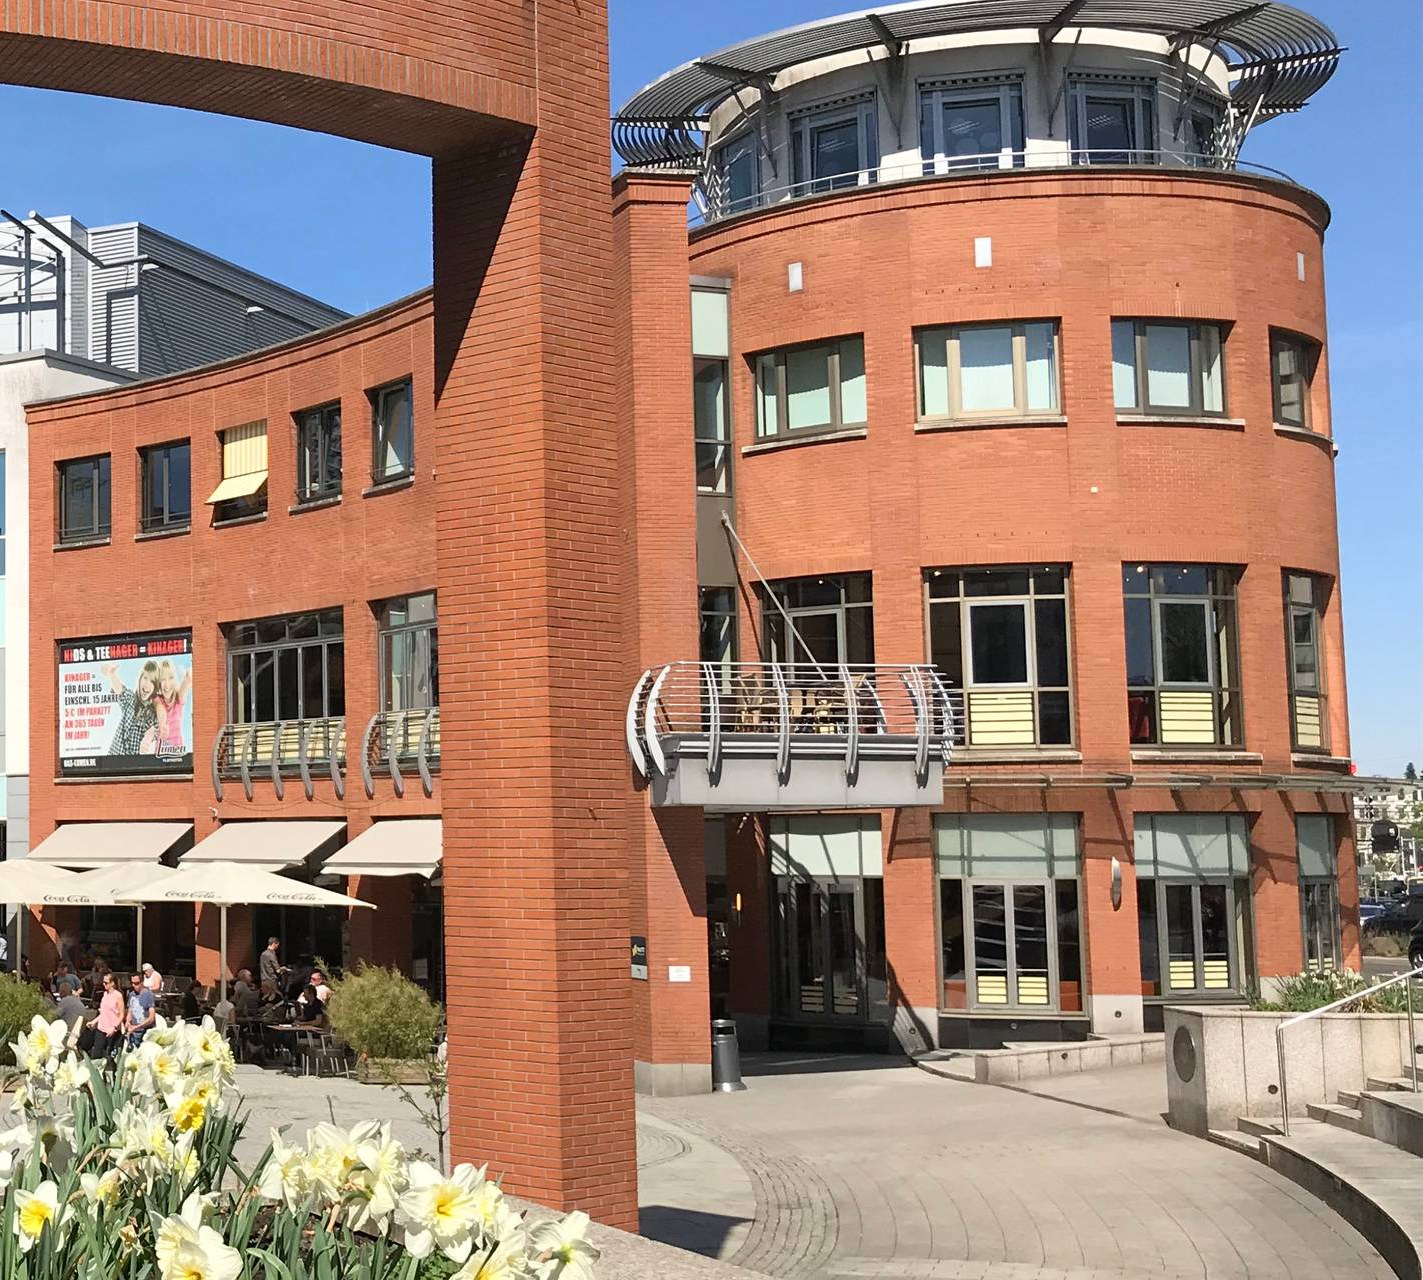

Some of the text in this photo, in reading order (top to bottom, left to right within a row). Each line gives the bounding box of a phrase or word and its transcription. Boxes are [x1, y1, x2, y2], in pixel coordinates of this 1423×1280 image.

[87, 649, 94, 661] &
[95, 643, 138, 660] TEENAGER
[77, 683, 91, 693] ALLE
[91, 682, 103, 692] BIS
[92, 694, 100, 704] 15
